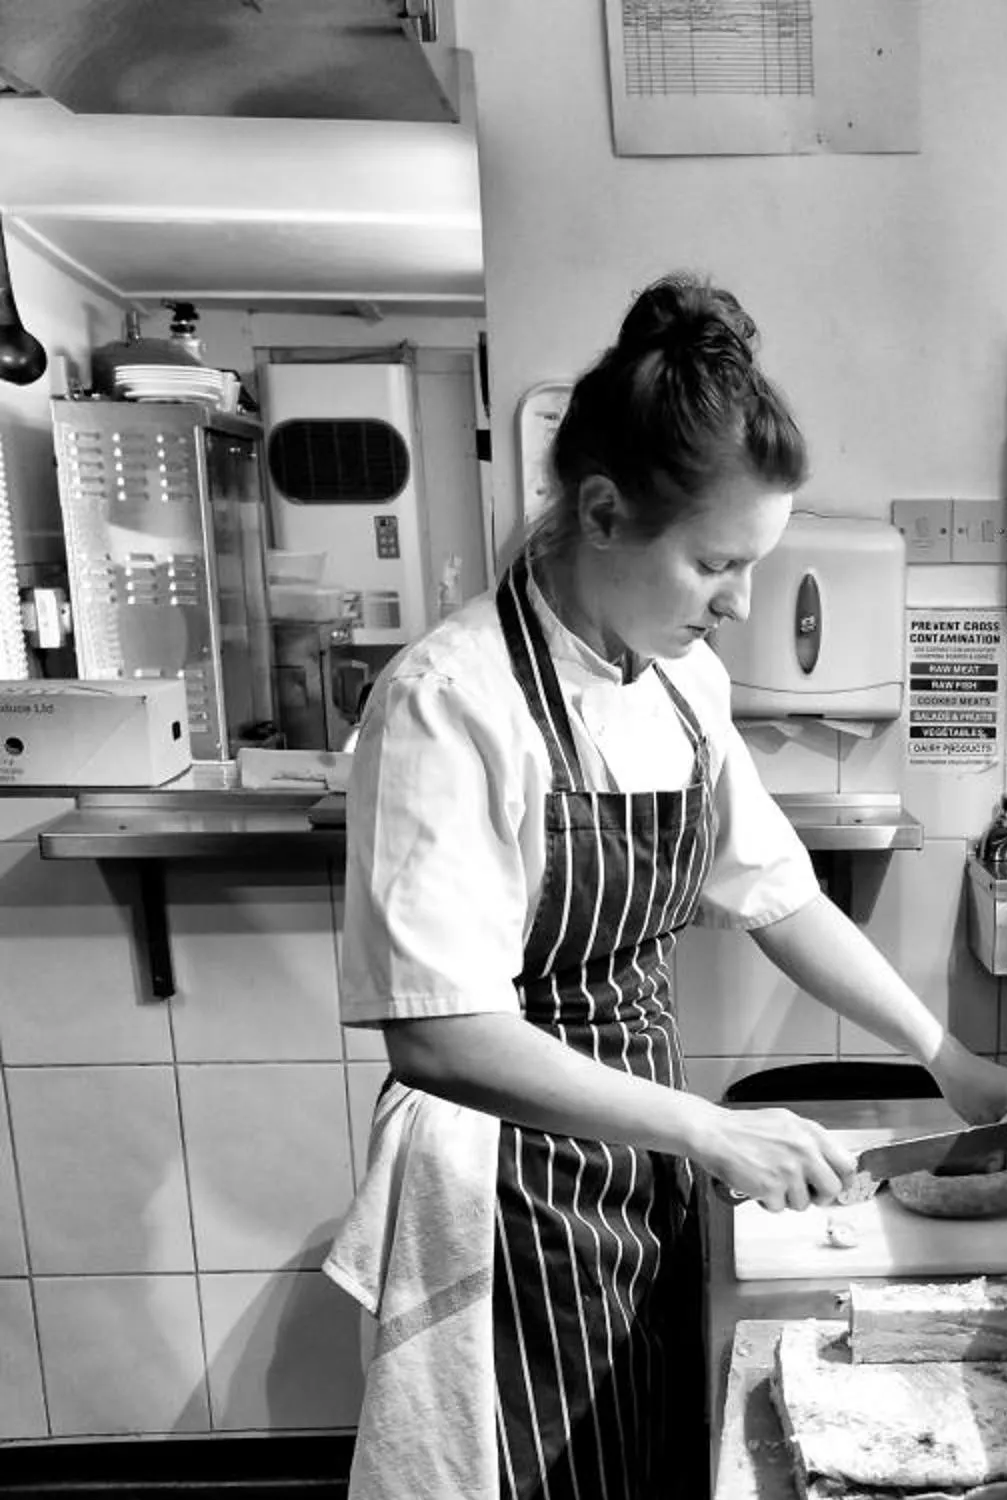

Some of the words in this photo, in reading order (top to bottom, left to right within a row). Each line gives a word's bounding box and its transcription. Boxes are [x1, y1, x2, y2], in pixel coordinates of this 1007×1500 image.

[911, 621, 960, 631] PREVENT
[963, 621, 1000, 631] CROSS
[909, 633, 1001, 644] CONTAMINATION
[929, 664, 952, 673] RAW
[953, 665, 981, 674] MEAT
[931, 681, 954, 689] RAW
[955, 681, 977, 690] FISH
[917, 696, 957, 705] COOKED
[959, 697, 991, 706] MEATS
[921, 727, 985, 737] VEGETABLES
[913, 743, 941, 753] DAIRY
